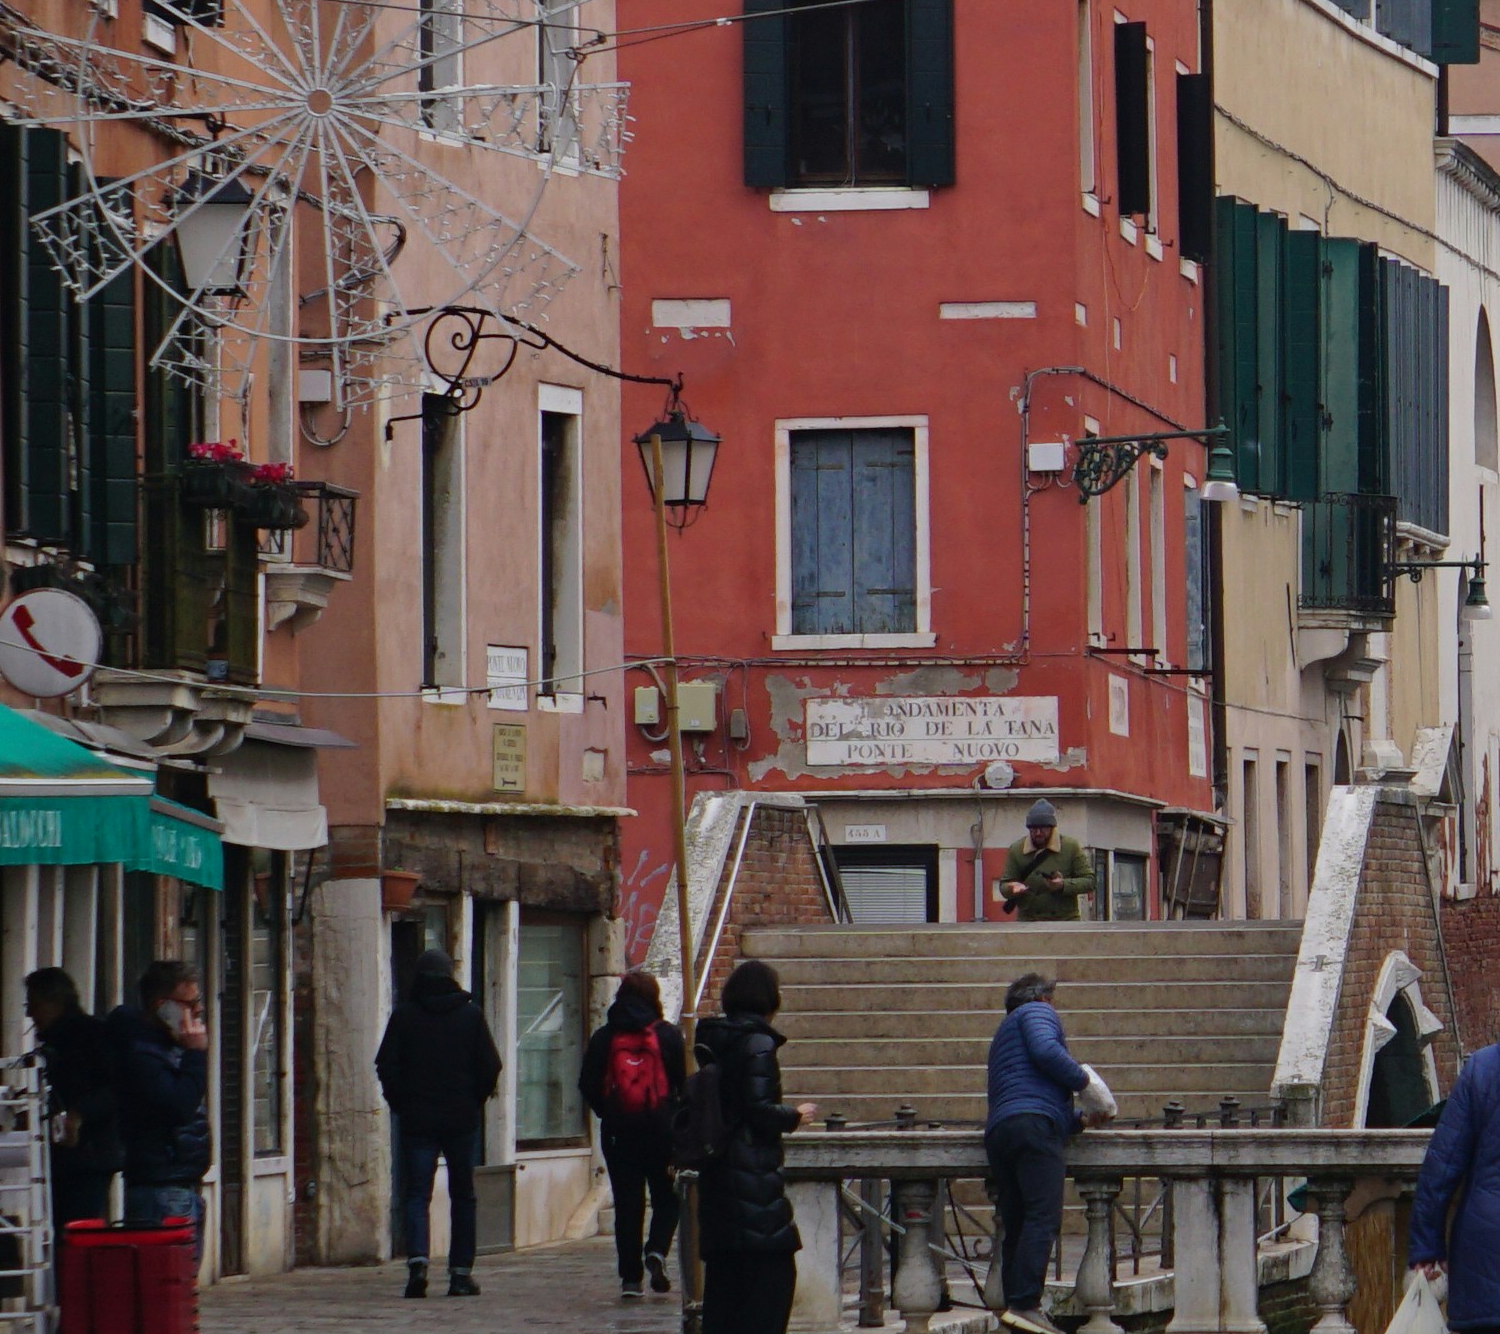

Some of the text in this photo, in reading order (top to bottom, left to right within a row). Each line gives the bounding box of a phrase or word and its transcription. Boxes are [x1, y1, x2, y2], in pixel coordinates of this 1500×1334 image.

[870, 721, 906, 737] RIO
[925, 721, 953, 736] DE
[967, 721, 993, 736] LA
[1004, 719, 1056, 736] TANA
[847, 742, 1020, 759] PONTE NUOVO
